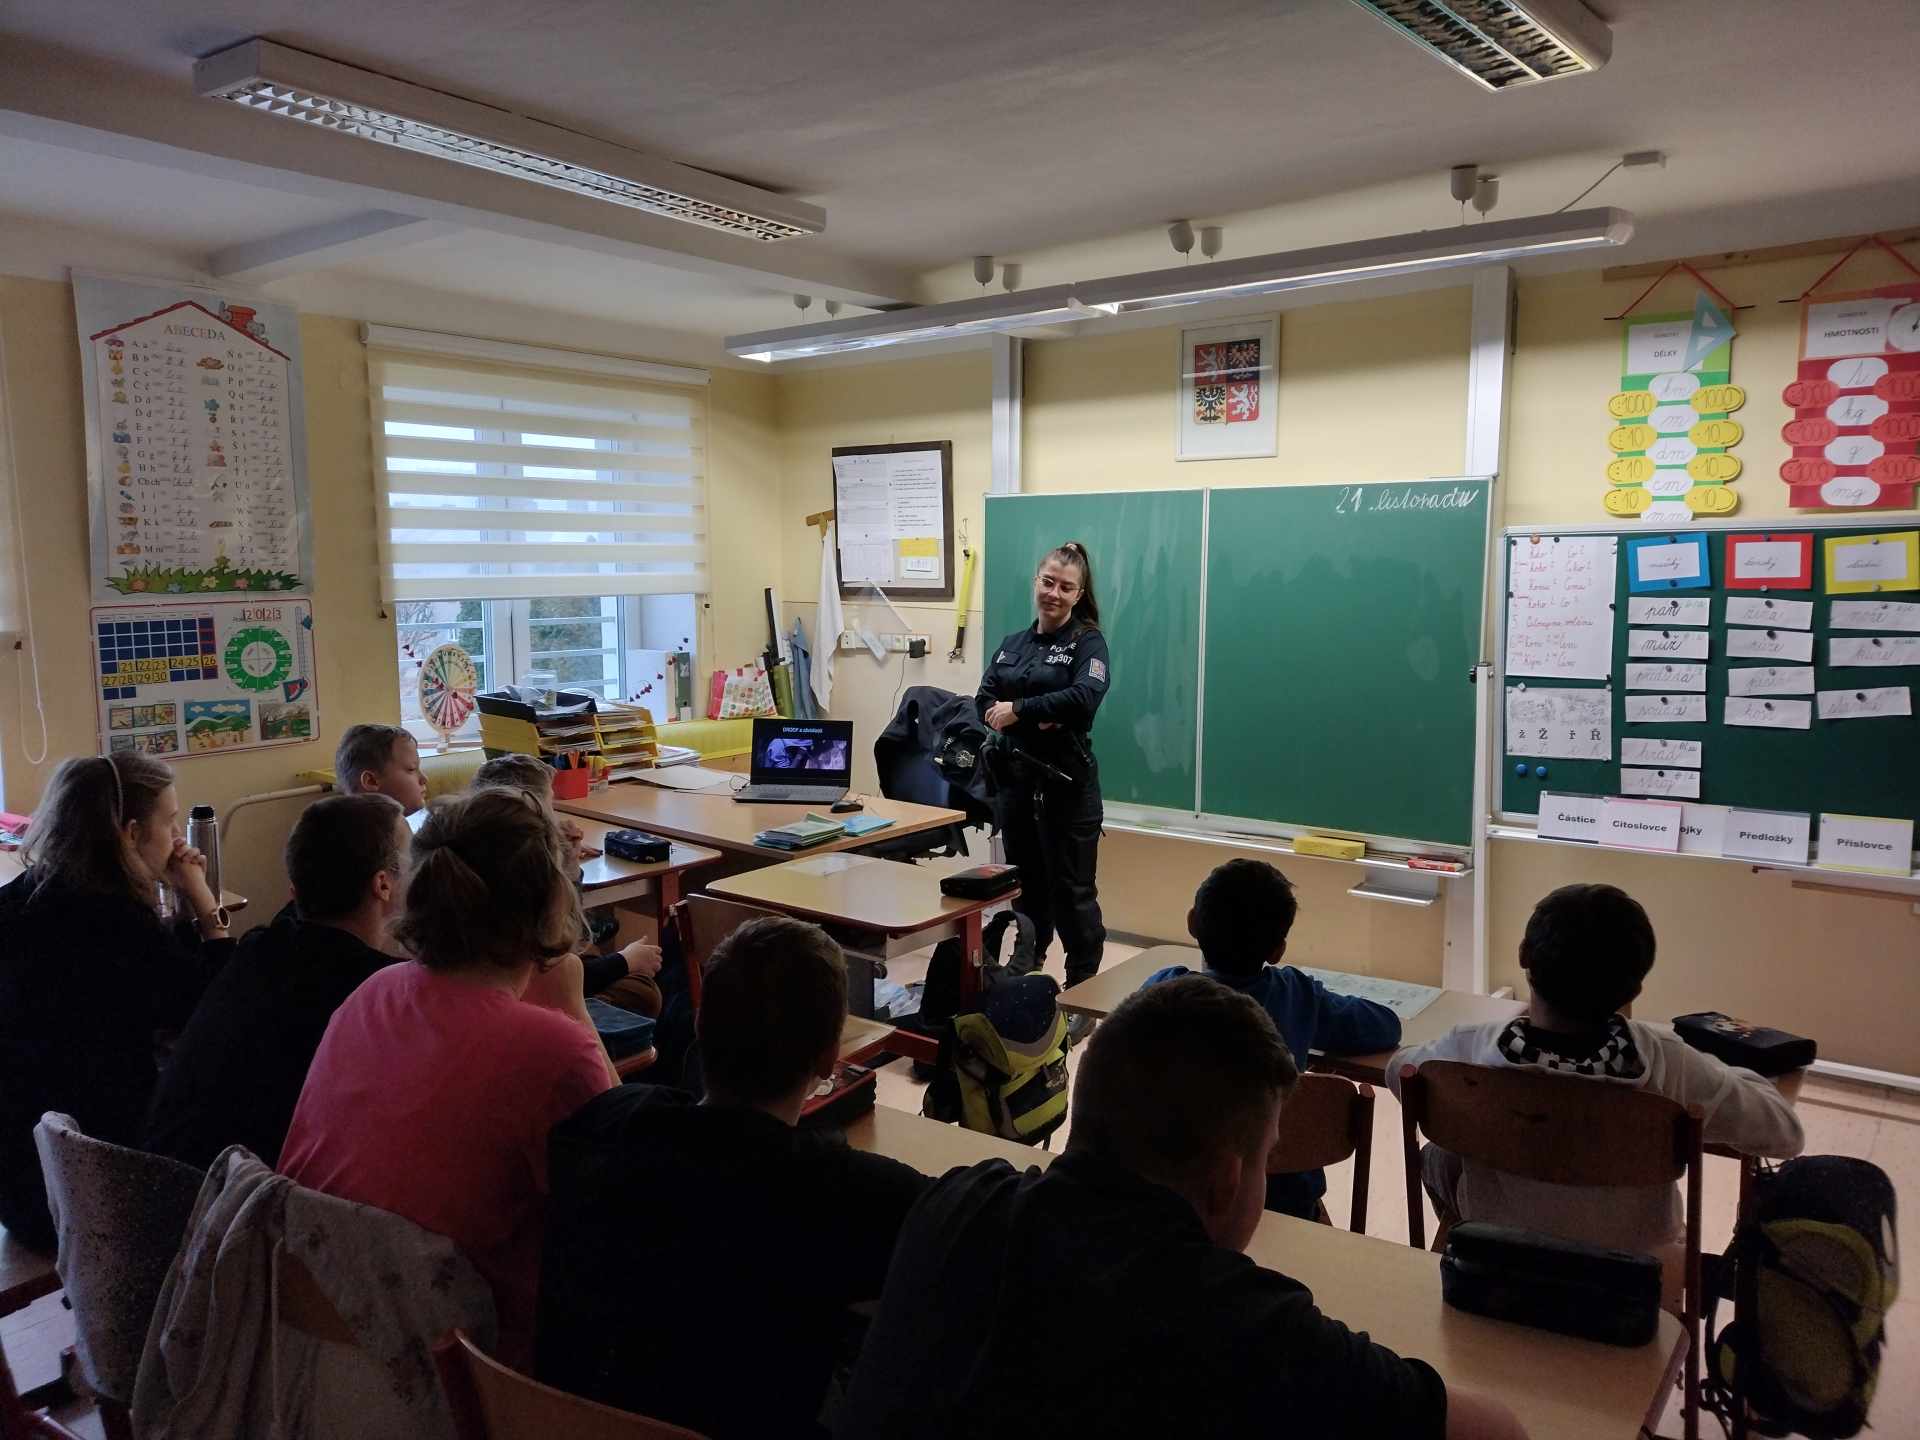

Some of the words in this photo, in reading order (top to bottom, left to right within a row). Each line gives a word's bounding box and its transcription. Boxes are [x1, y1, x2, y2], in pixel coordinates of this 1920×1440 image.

[163, 324, 224, 341] ABECEDA
[1823, 327, 1880, 338] HMOTNOSTI
[1557, 812, 1597, 824] Částice
[1612, 819, 1669, 833] Citoslovce
[1738, 830, 1794, 845] Předložky
[1836, 837, 1894, 851] Příslovce
